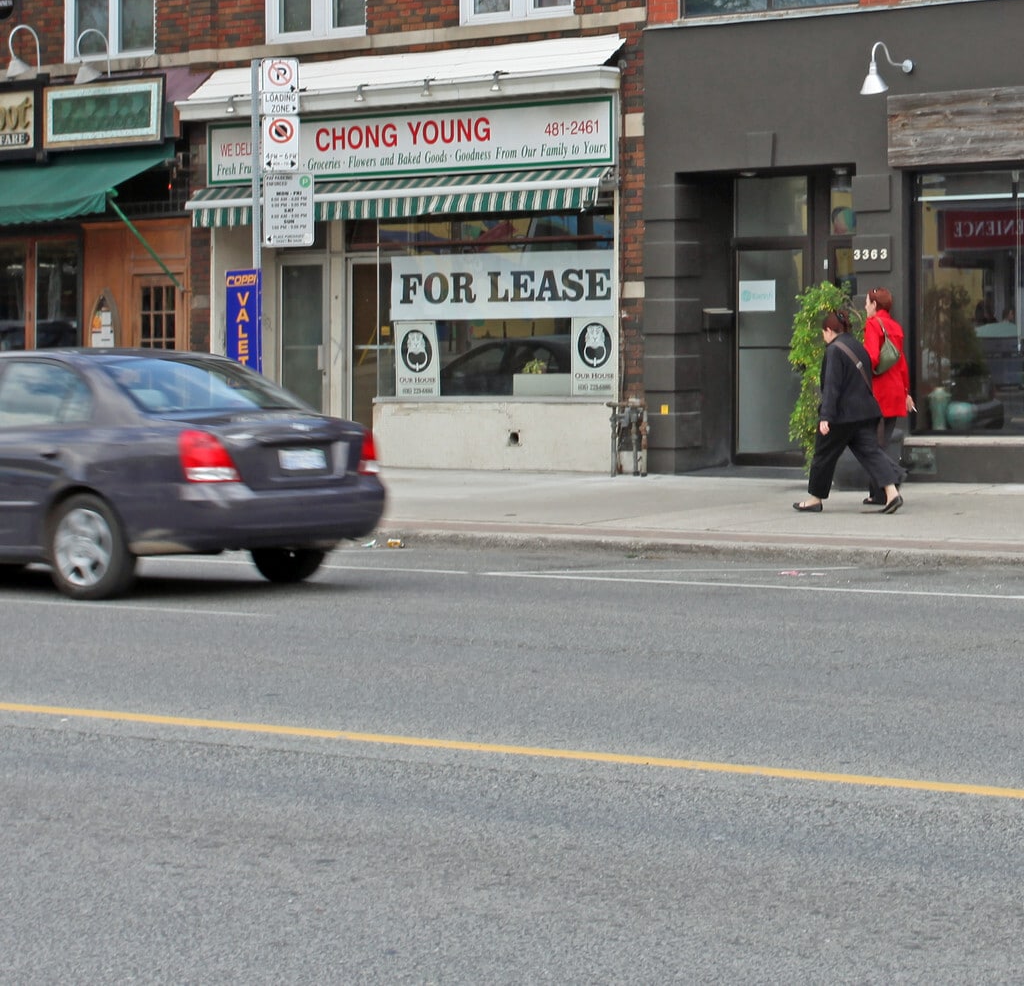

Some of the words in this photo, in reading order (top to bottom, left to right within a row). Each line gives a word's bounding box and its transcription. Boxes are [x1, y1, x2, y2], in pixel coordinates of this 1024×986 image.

[265, 94, 296, 103] LOADING
[271, 104, 290, 113] ZONE
[315, 123, 398, 152] CHONG
[406, 116, 491, 146] YOUNG
[544, 119, 599, 137] 481-2461
[216, 162, 236, 176] Fresh
[307, 156, 342, 171] Groceries
[348, 154, 377, 168] Flowers
[380, 155, 395, 166] and
[398, 151, 421, 165] Baked
[424, 149, 448, 164] Goods
[454, 147, 492, 162] Goodness
[495, 146, 517, 160] From
[521, 145, 537, 158] Our
[540, 142, 568, 159] Family
[571, 144, 580, 156] to
[583, 140, 607, 155] Yours
[220, 143, 233, 157] WE
[853, 248, 888, 260] 3363
[226, 274, 257, 287] COPPI
[400, 271, 477, 305] FOR
[487, 268, 612, 303] LEASE
[235, 291, 250, 366] VALET
